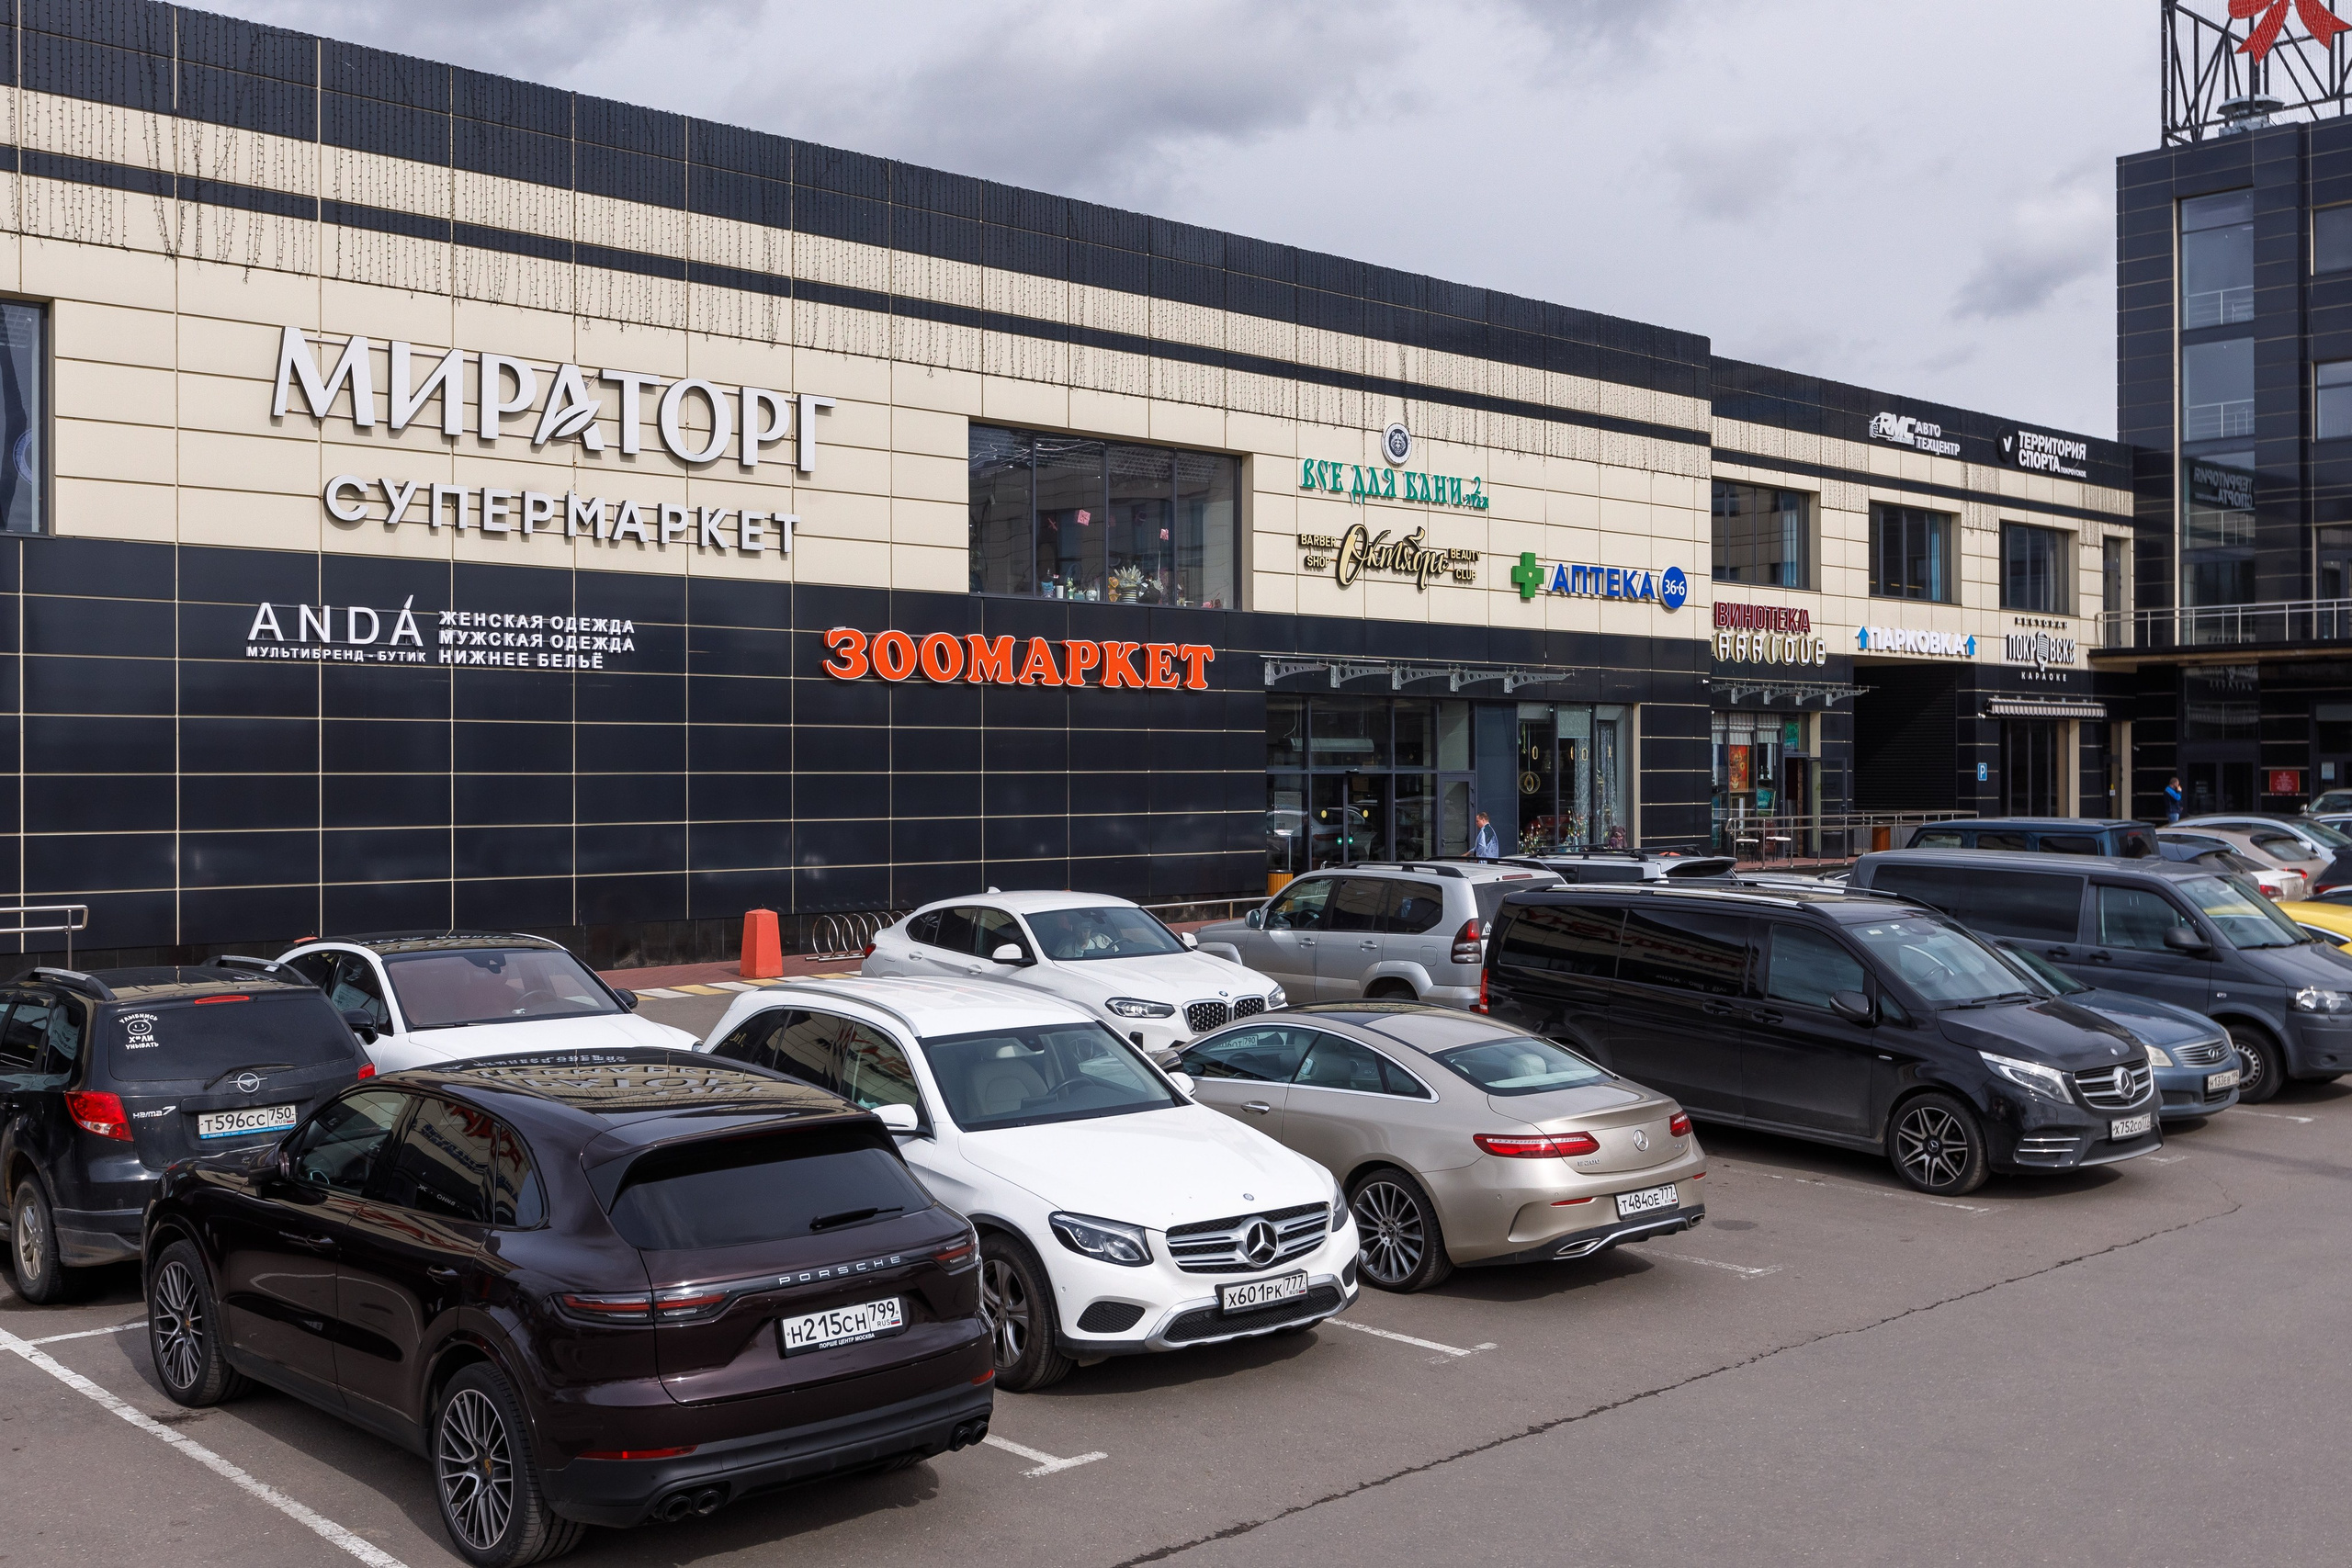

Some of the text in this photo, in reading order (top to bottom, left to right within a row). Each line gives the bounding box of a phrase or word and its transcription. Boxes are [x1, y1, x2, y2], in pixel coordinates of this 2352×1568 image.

[271, 326, 836, 472] МИРАТОРГ
[1879, 412, 1917, 439] RMC
[1915, 422, 1940, 437] АВТО
[1916, 436, 1961, 456] ТЕХЦЕНТР
[2018, 431, 2086, 460] ТЕРРИТОРИЯ
[2018, 448, 2061, 473] СПОРТА
[1300, 458, 1464, 505] ВСЕ ДЛЯ БАНИ
[1473, 476, 1481, 494] 2
[323, 474, 802, 552] СУПЕРМАРКЕТ
[1300, 534, 1337, 547] BARBER
[1306, 556, 1331, 567] SHOP
[1451, 548, 1481, 561] BEAUTY
[1455, 569, 1476, 580] CLUB
[1548, 563, 1655, 600] АПТЕКА
[439, 611, 635, 634] ЖЕНСКАЯ ОДЕЖДА
[1714, 602, 1811, 633] ВИНОТЕКА
[2015, 617, 2068, 628] РЕСТОРАН
[439, 628, 635, 651] МУЖСКАЯ ОДЕЖДА
[1869, 626, 1966, 656] ПАРКОВКА
[438, 649, 605, 670] НИЖНЕЕ БЕЛЬЁ
[822, 626, 1215, 690] ЗООМАРКЕТ
[2021, 671, 2066, 682] КАРАОКЕ
[119, 1013, 158, 1023] УЛЫБНИСЬ
[126, 1042, 159, 1050] УНЫВАТЬ
[204, 1113, 266, 1132] Т596СС
[268, 1107, 292, 1121] 750
[1622, 1186, 1673, 1212] Т484ОЕ 777
[779, 1256, 900, 1285] PORSCHE
[1228, 1284, 1283, 1307] Х601РК
[1284, 1275, 1304, 1291] 777
[791, 1301, 895, 1344] Н215СН 799
[876, 1319, 890, 1327] RUS
[819, 1333, 875, 1349] ПОРШЕ ЦЕНТР МОСКВА
